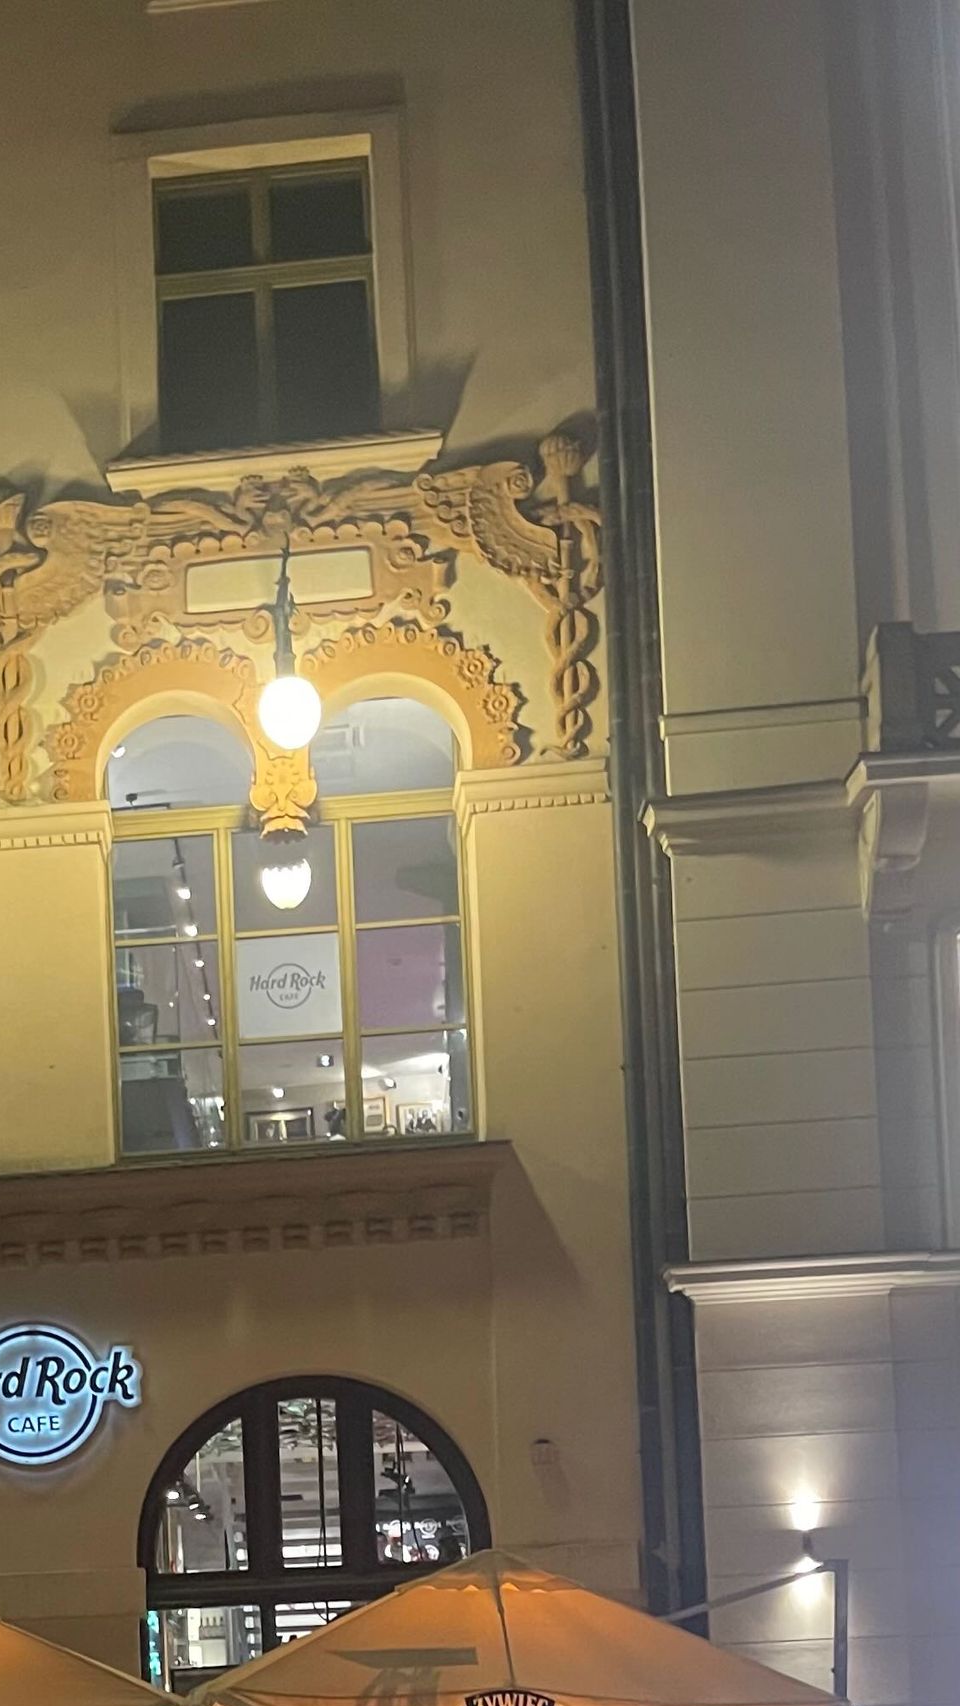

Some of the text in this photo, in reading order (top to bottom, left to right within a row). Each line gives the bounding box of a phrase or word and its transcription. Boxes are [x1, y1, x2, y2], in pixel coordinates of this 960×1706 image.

[250, 970, 326, 992] Hard Rock
[36, 1351, 134, 1406] Rock
[7, 1415, 61, 1433] CAFE
